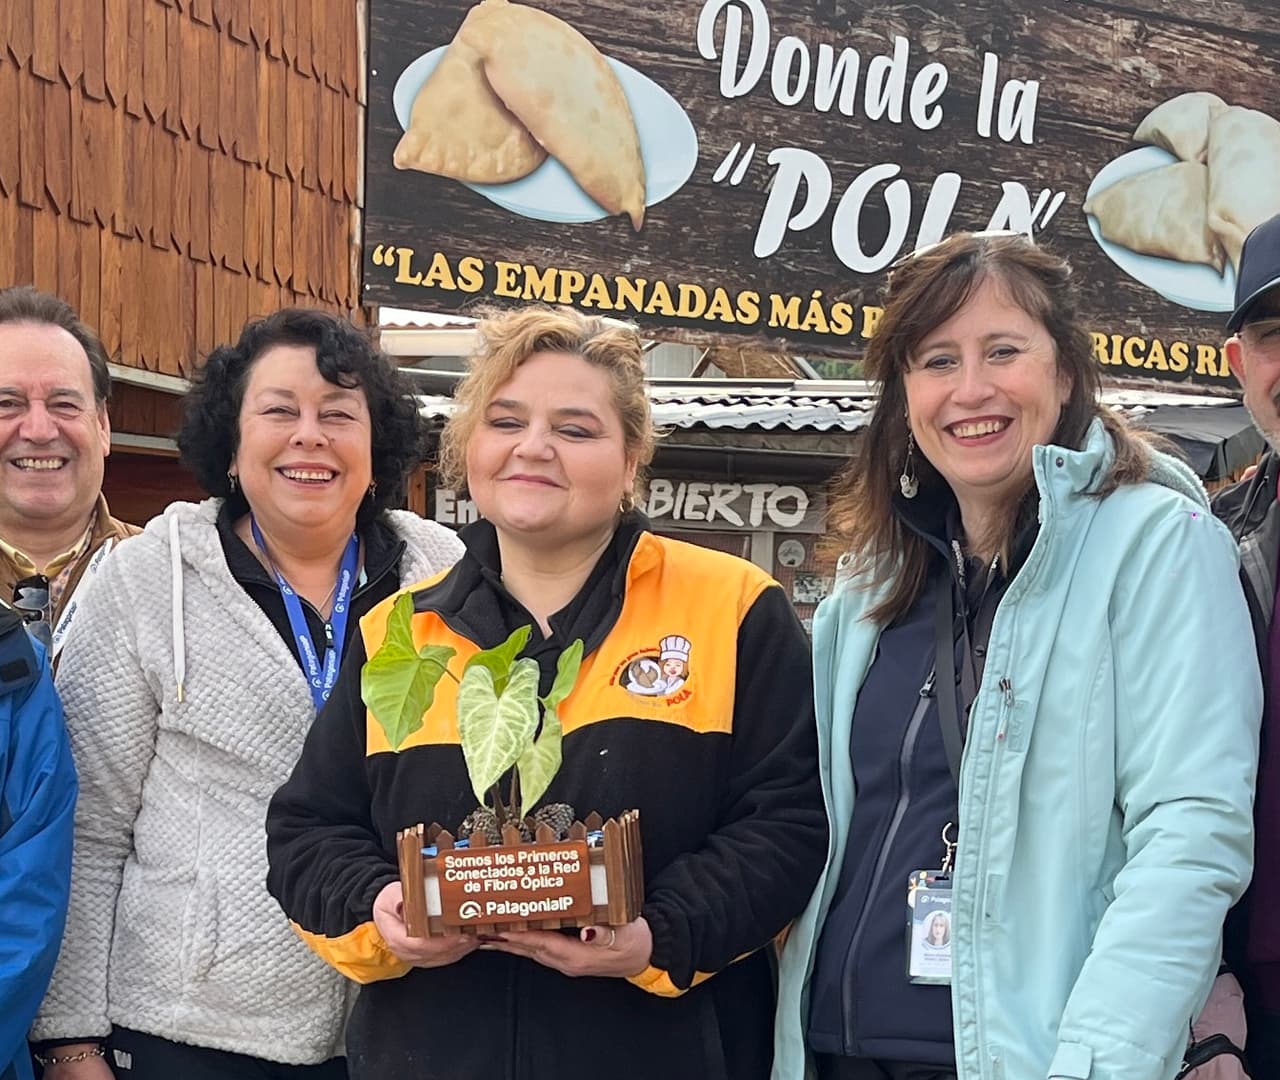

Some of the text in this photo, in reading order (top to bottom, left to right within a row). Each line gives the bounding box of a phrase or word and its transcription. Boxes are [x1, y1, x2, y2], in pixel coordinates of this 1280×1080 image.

[696, 0, 1040, 145] Donde la
[493, 261, 761, 325] EMPANADAS
[768, 290, 854, 336] MÁS
[1089, 331, 1189, 373] RICAS
[642, 478, 810, 527] BIERTO
[444, 849, 578, 868] Somos los Primeros
[444, 861, 581, 882] Conectados a la Red
[463, 881, 481, 894] de
